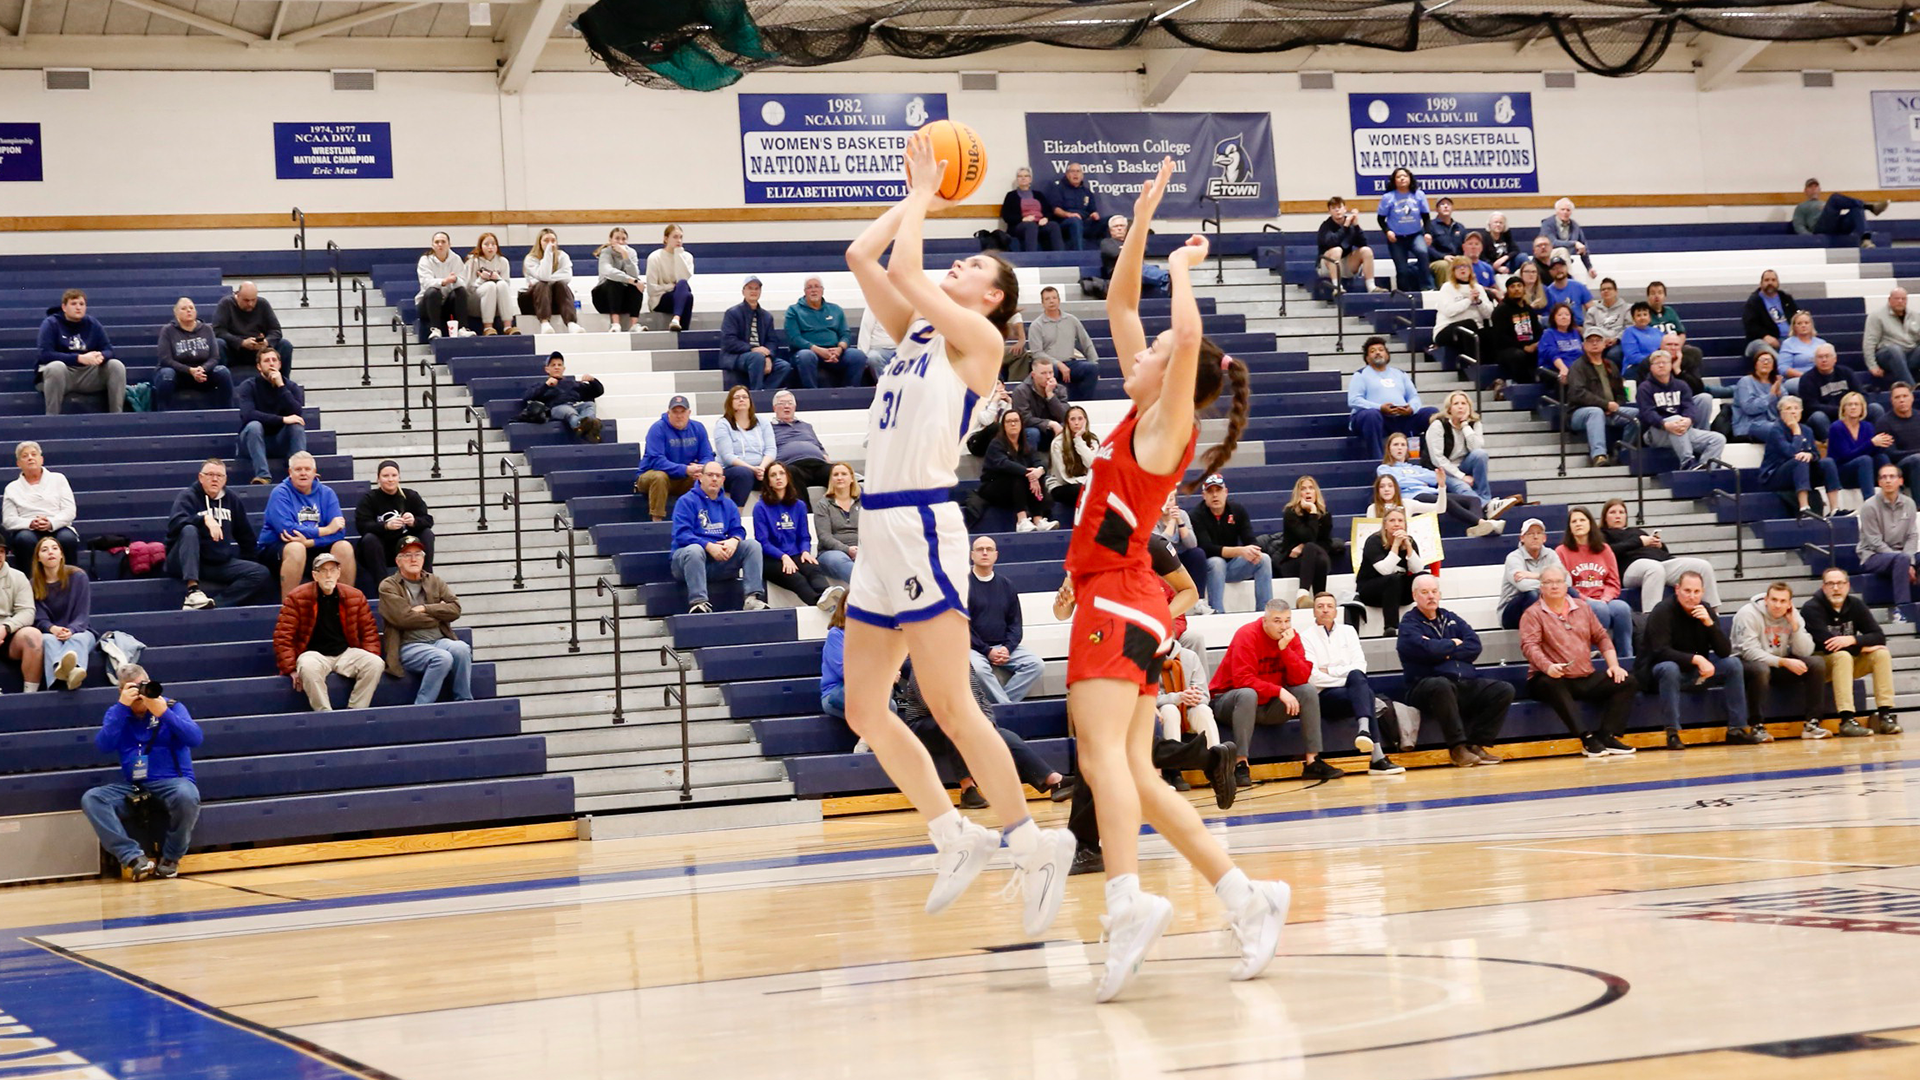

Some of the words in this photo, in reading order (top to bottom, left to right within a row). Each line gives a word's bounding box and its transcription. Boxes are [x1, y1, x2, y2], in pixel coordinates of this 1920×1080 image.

[828, 98, 862, 113] 1982
[1427, 98, 1457, 112] 1989
[805, 115, 842, 126] NCAA
[844, 114, 868, 126] DIV.
[871, 114, 886, 125] III
[1407, 113, 1440, 123] NCAA
[1440, 113, 1462, 123] DIV.
[1464, 112, 1478, 123] III
[310, 125, 333, 134] 1974,
[335, 125, 356, 133] 1977
[295, 133, 329, 143] NCAA
[331, 133, 355, 142] DIV.
[357, 133, 371, 142] III
[760, 137, 832, 150] WOMEN'S
[838, 136, 906, 150] BASKETB
[1368, 134, 1431, 146] WOMEN'S
[1436, 132, 1520, 145] BASKETBALL
[311, 146, 356, 155] WRESTLING
[1043, 140, 1140, 154] Elizabethtown
[1143, 139, 1191, 155] College
[293, 155, 332, 164] NATIONAL
[333, 155, 375, 164] CHAMPION
[964, 127, 980, 182] Wilson
[1360, 151, 1439, 168] NATIONAL
[1443, 149, 1531, 167] CHAMPIONS
[312, 167, 333, 175] Eric
[334, 166, 358, 175] Mast
[750, 155, 840, 175] NATIONAL
[845, 154, 905, 174] CHAMP
[1052, 160, 1114, 174] Wmen's
[1118, 159, 1187, 174] Basketall
[1210, 180, 1258, 196] ETOWN
[1470, 177, 1521, 190] COLLEGE
[766, 186, 875, 199] ELIZABETHTOWN
[876, 185, 908, 198] COLL
[879, 388, 903, 430] 31
[1571, 562, 1607, 577] CATHOLIC
